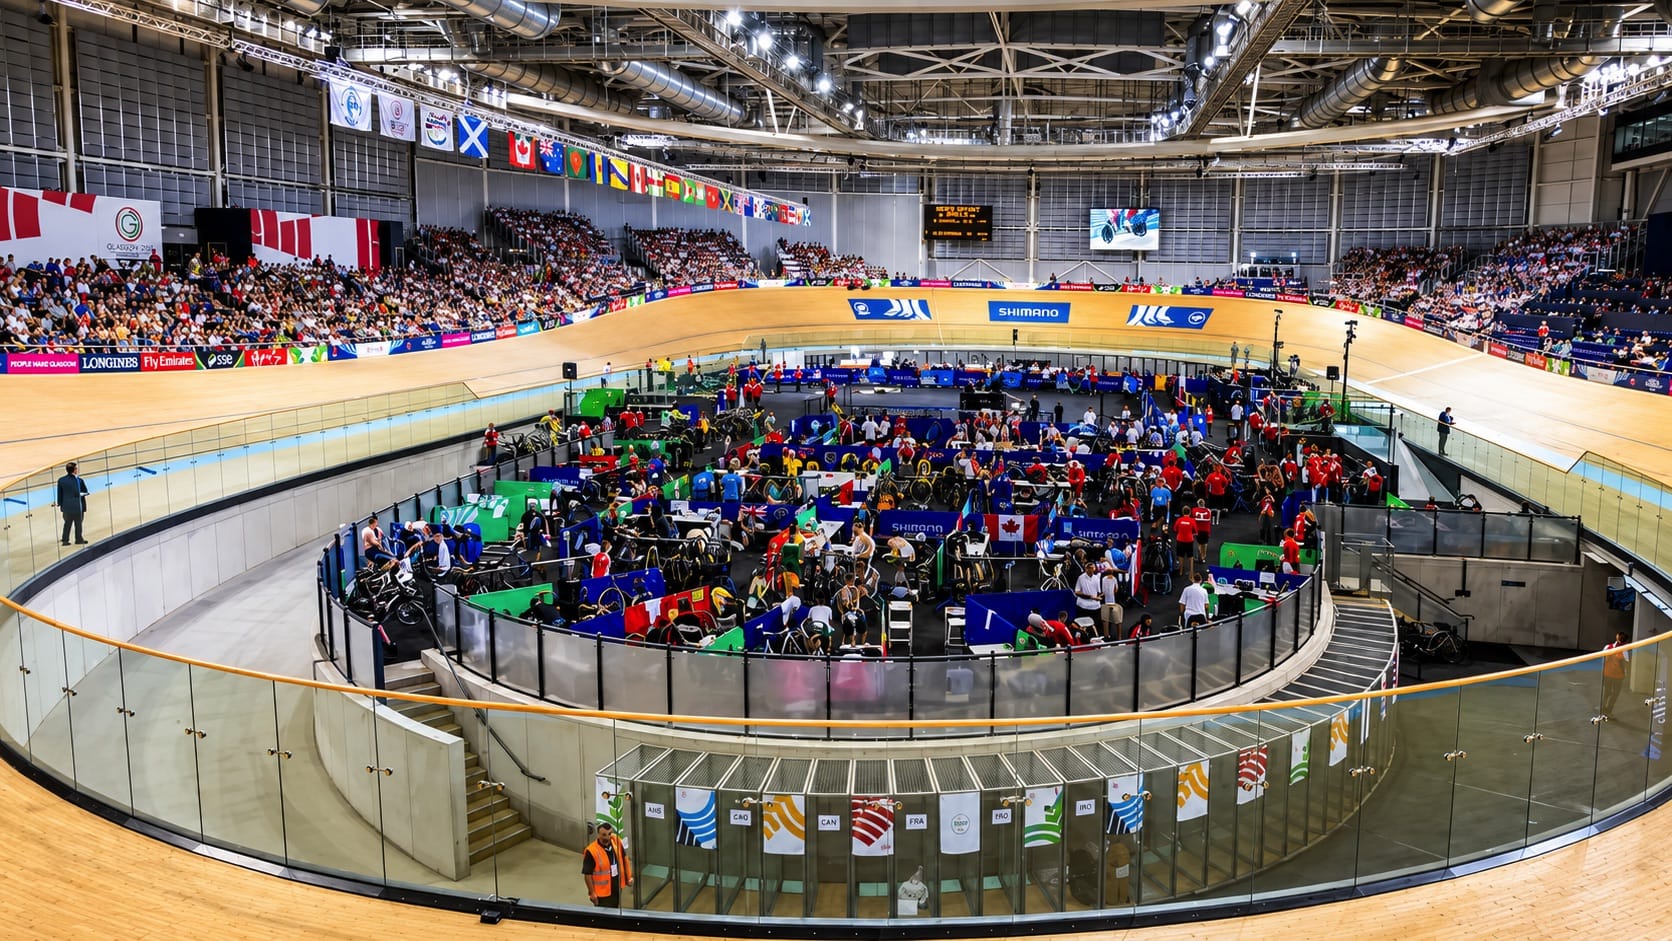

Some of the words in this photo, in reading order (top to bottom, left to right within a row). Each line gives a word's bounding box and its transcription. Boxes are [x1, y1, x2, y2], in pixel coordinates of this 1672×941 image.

[998, 307, 1059, 317] SHIMANO
[82, 357, 138, 369] LONGINES
[143, 356, 158, 369] Fly
[159, 354, 194, 366] Emirates
[216, 353, 232, 365] sse
